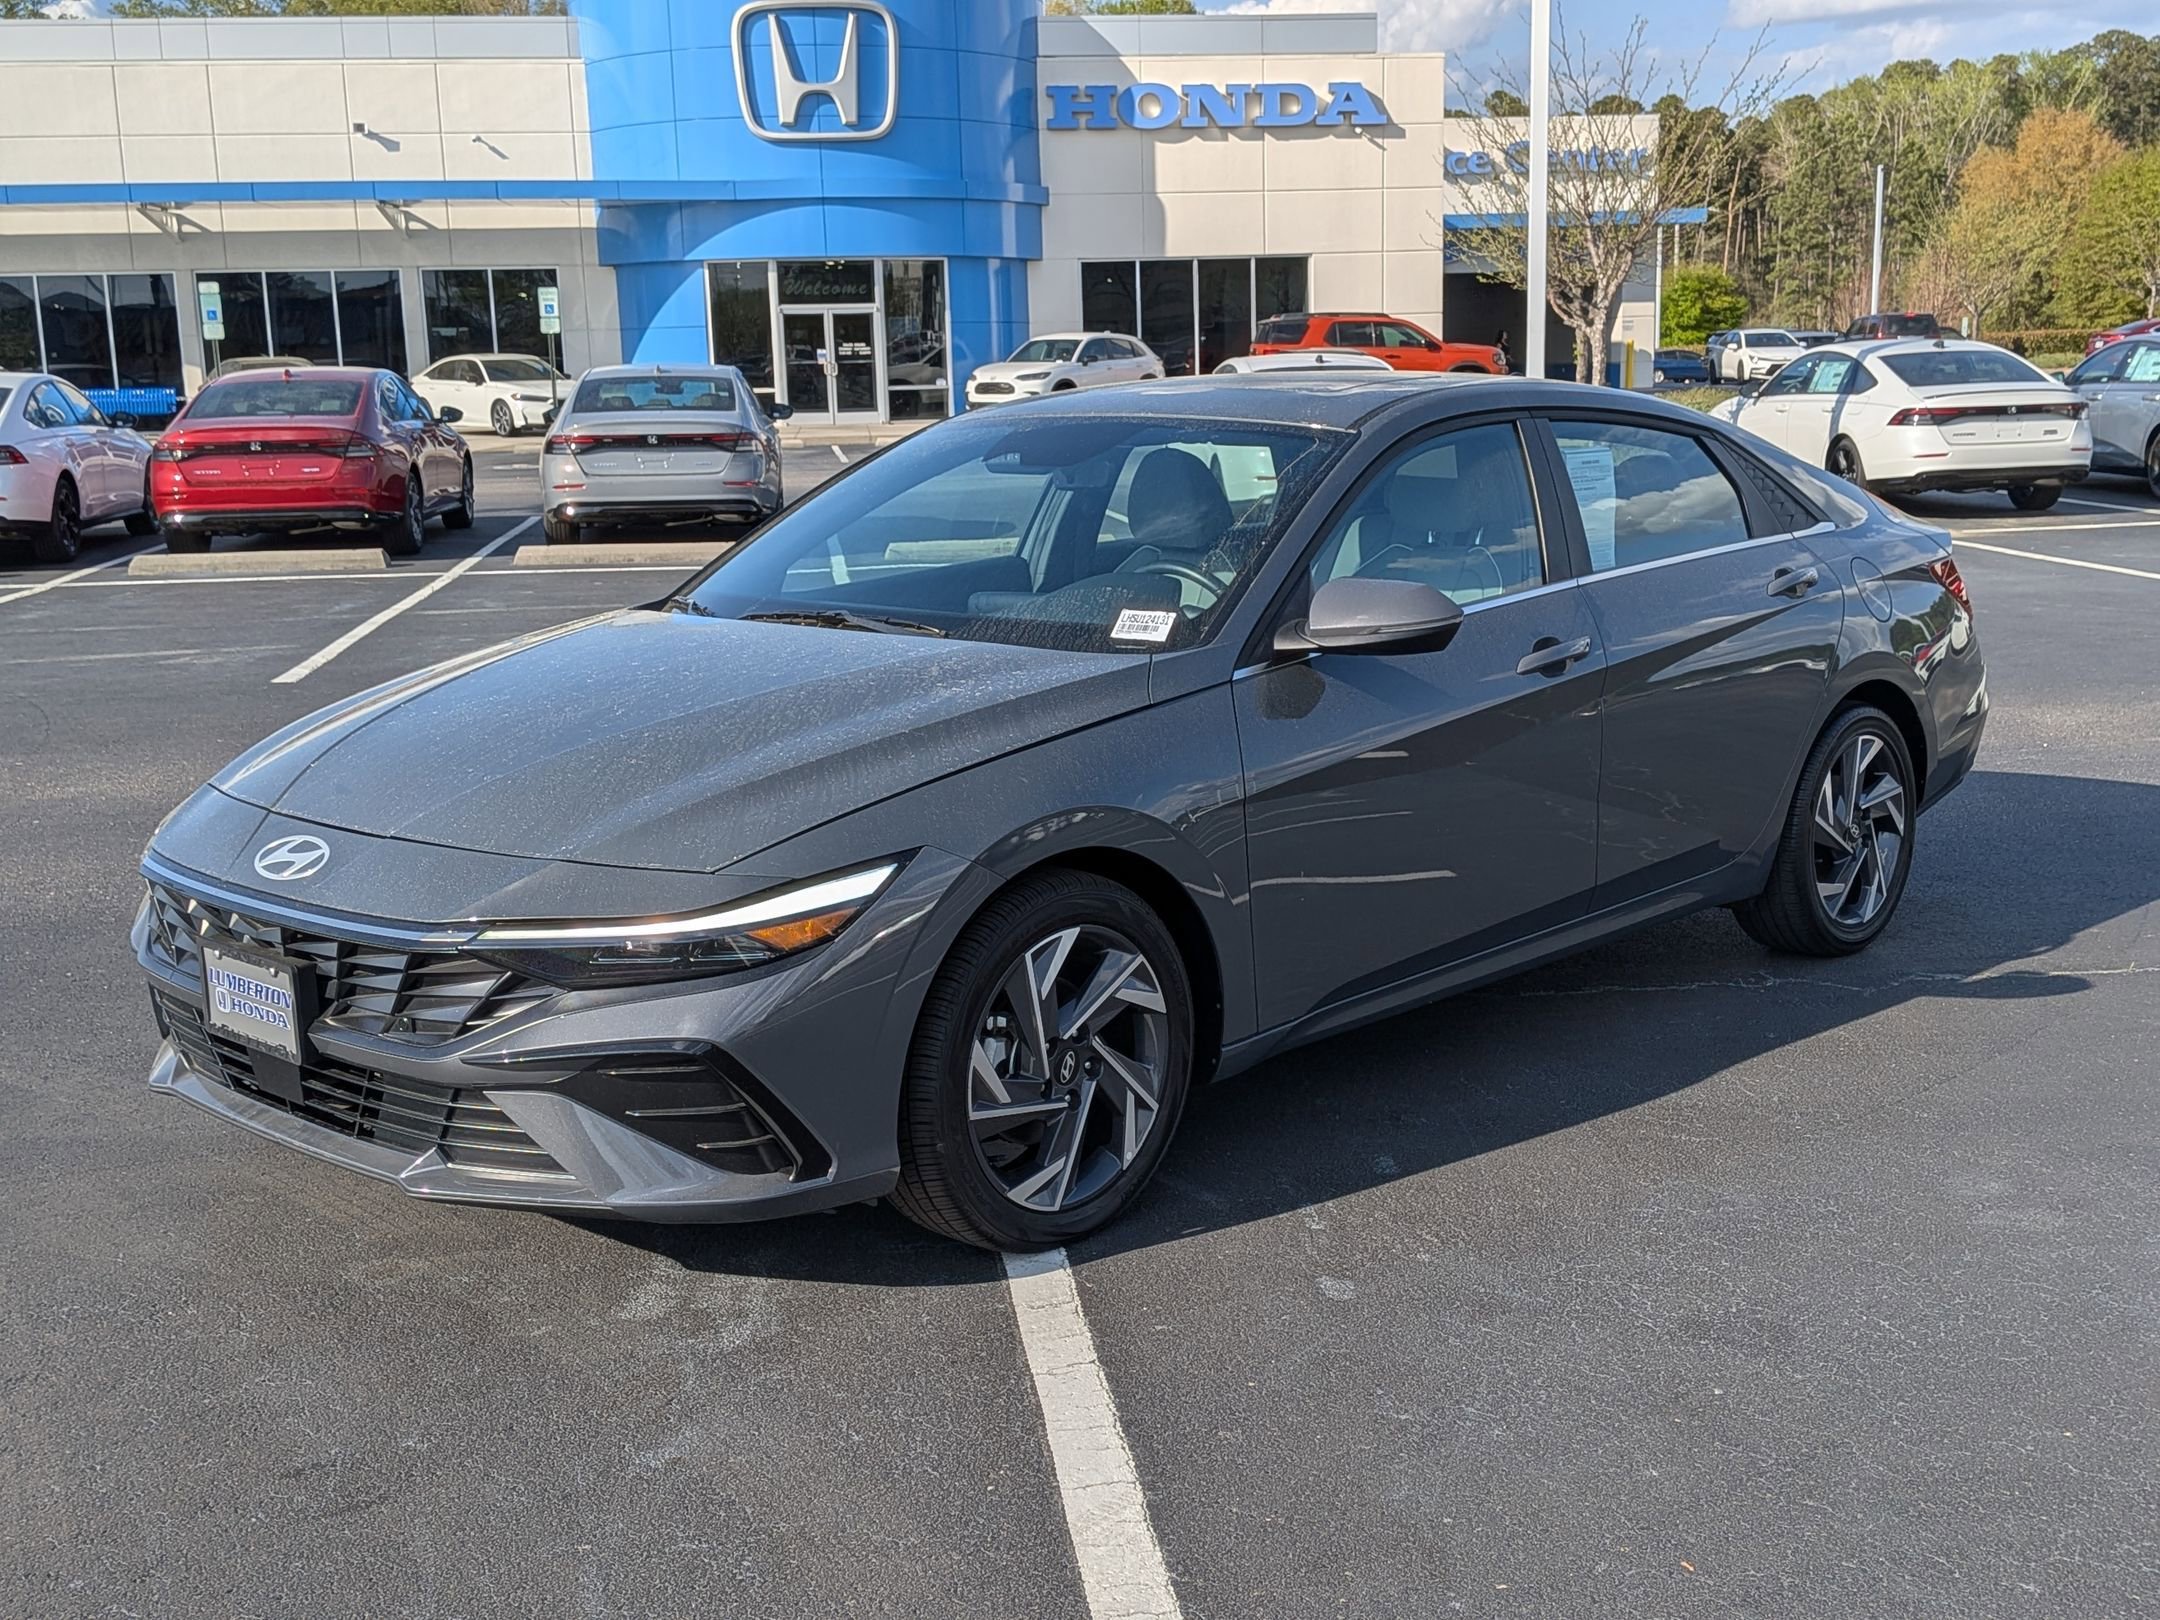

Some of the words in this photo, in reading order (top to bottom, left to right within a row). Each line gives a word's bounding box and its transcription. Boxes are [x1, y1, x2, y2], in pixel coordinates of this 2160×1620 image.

[1046, 82, 1387, 129] HONDA
[784, 279, 867, 295] Welcome
[209, 967, 291, 1009] LUMBERTON
[231, 997, 289, 1029] HONDA
